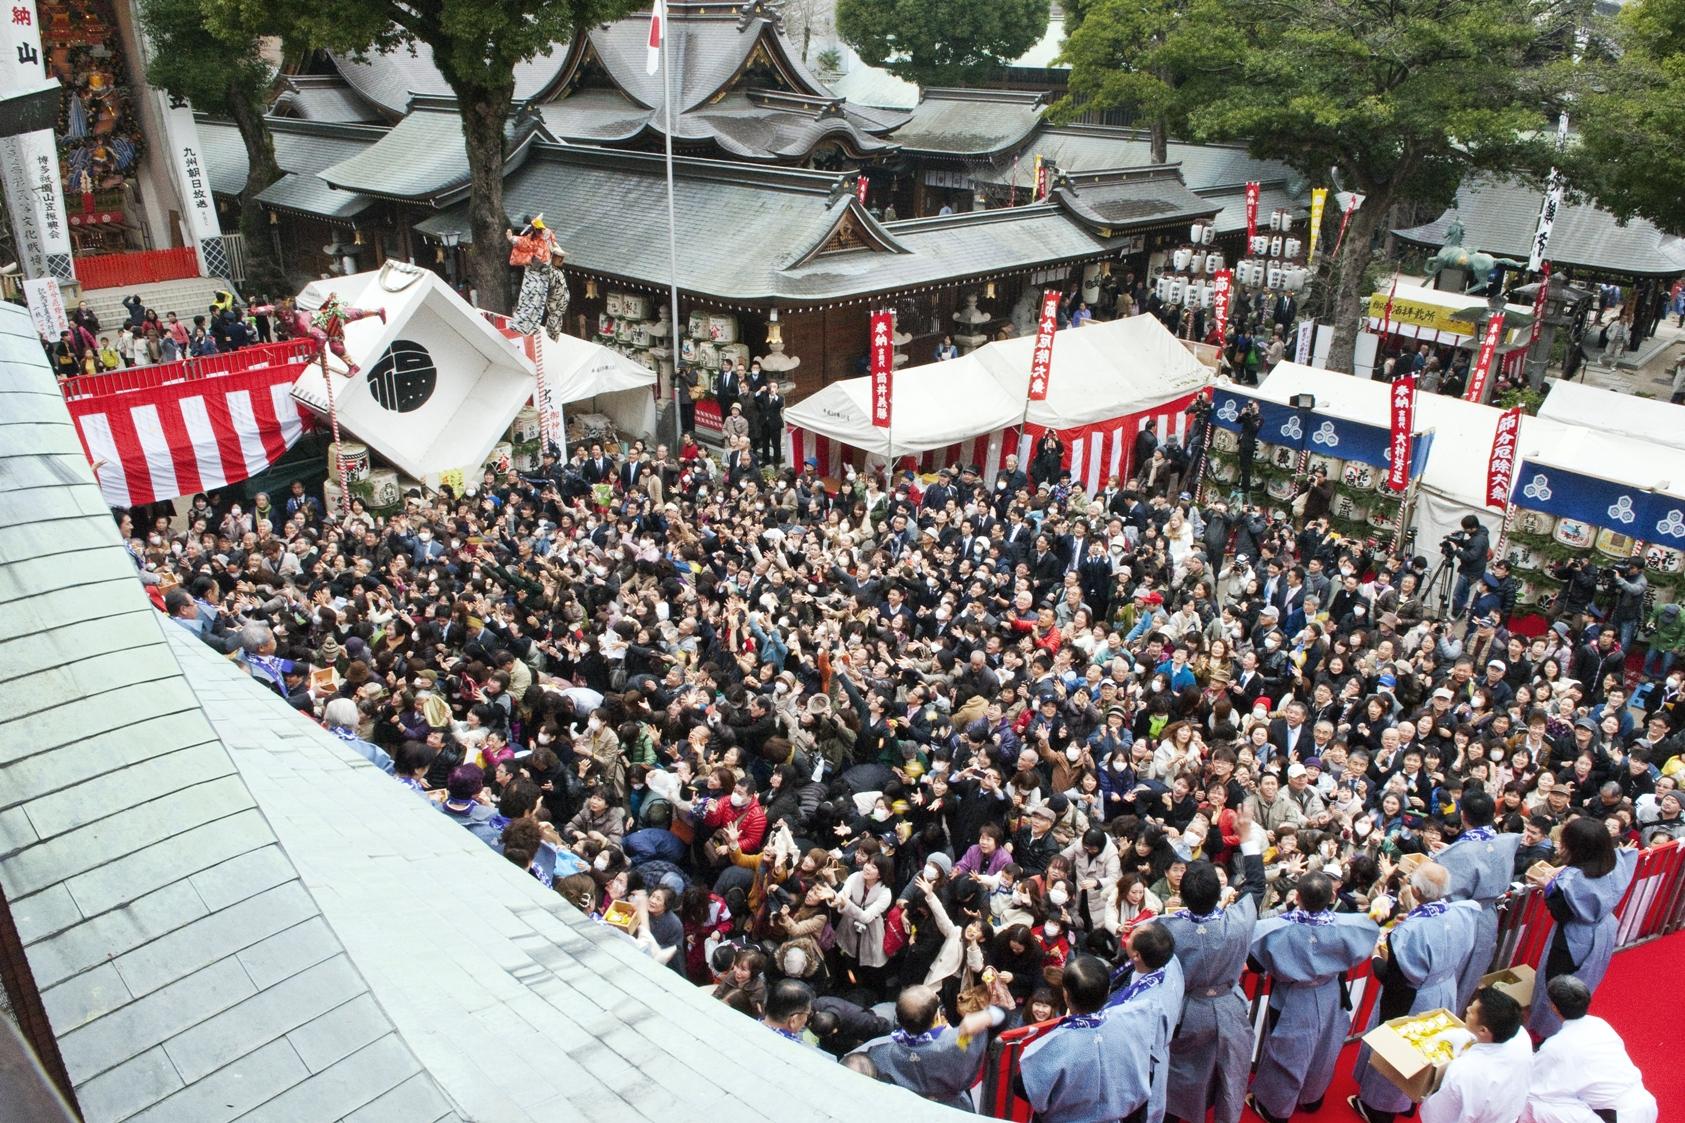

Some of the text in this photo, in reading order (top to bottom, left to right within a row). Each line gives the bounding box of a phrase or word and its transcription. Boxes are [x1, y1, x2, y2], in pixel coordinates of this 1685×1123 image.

[12, 0, 32, 26] 納
[16, 41, 38, 65] 山
[37, 154, 60, 239] 博多祇園山笠振興会
[183, 147, 208, 209] 九州朝日放送
[874, 321, 888, 347] 奉納
[1031, 300, 1057, 394] 節分厄除大祭
[1394, 384, 1410, 409] 奉納
[1490, 414, 1516, 503] 節分厄除大祭
